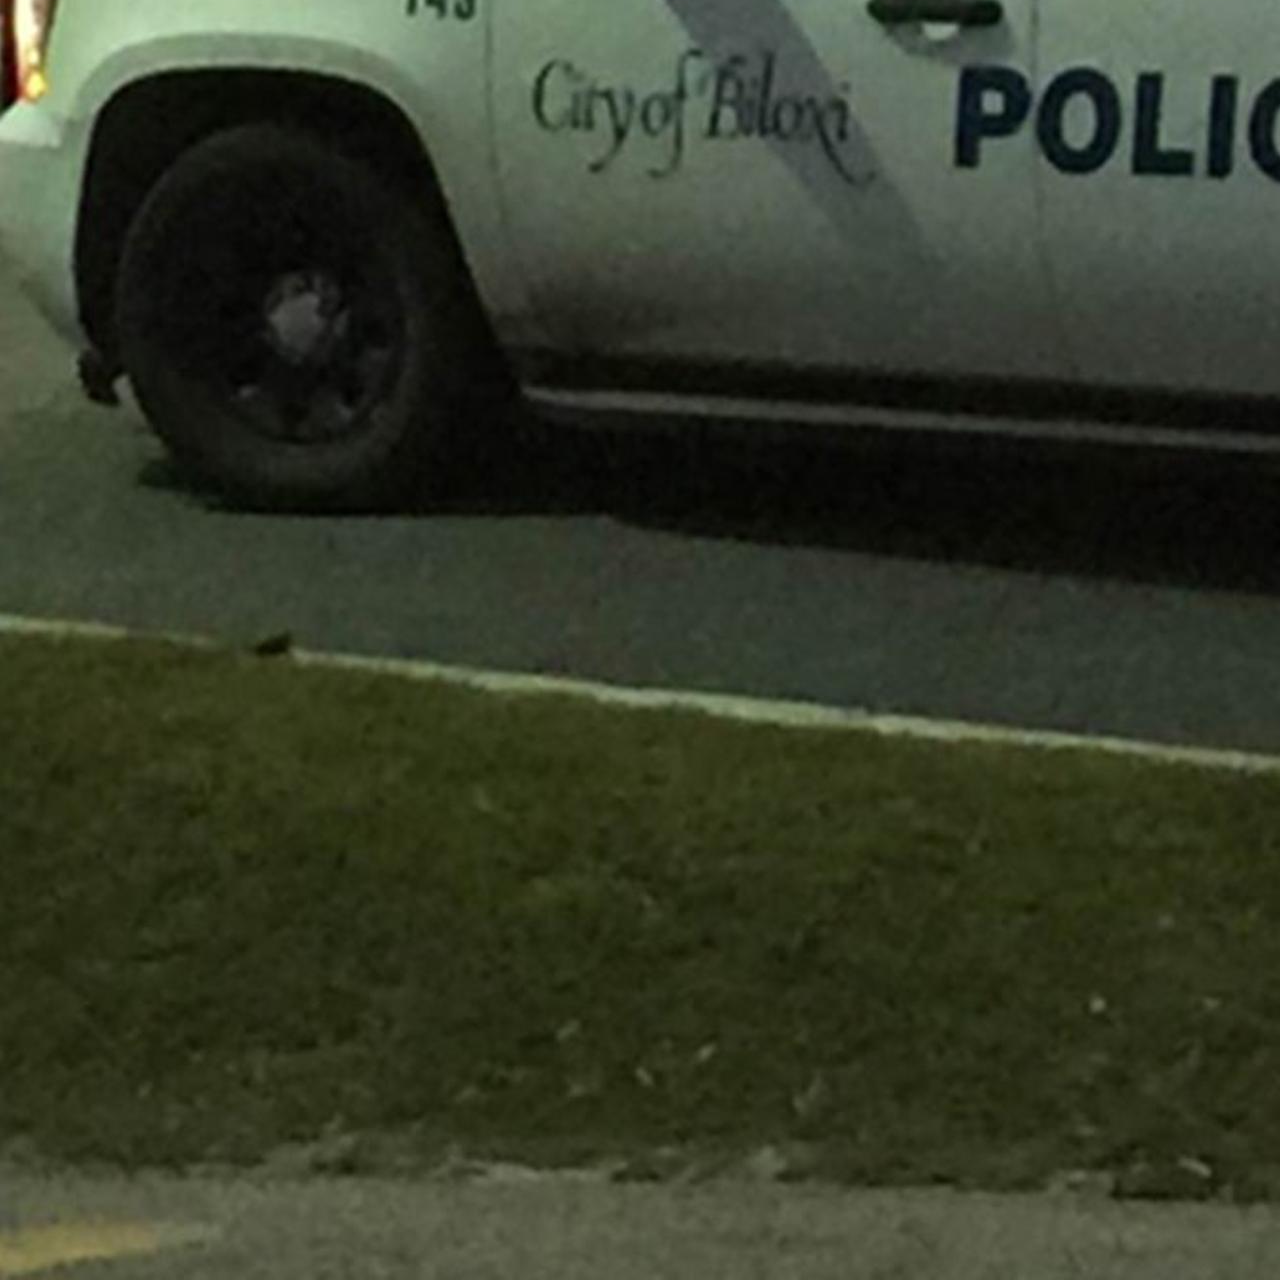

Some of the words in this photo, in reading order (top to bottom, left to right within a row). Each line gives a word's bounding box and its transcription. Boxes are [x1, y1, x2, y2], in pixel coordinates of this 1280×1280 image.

[531, 58, 635, 174] City
[640, 48, 704, 179] of
[704, 50, 878, 187] Biloxi
